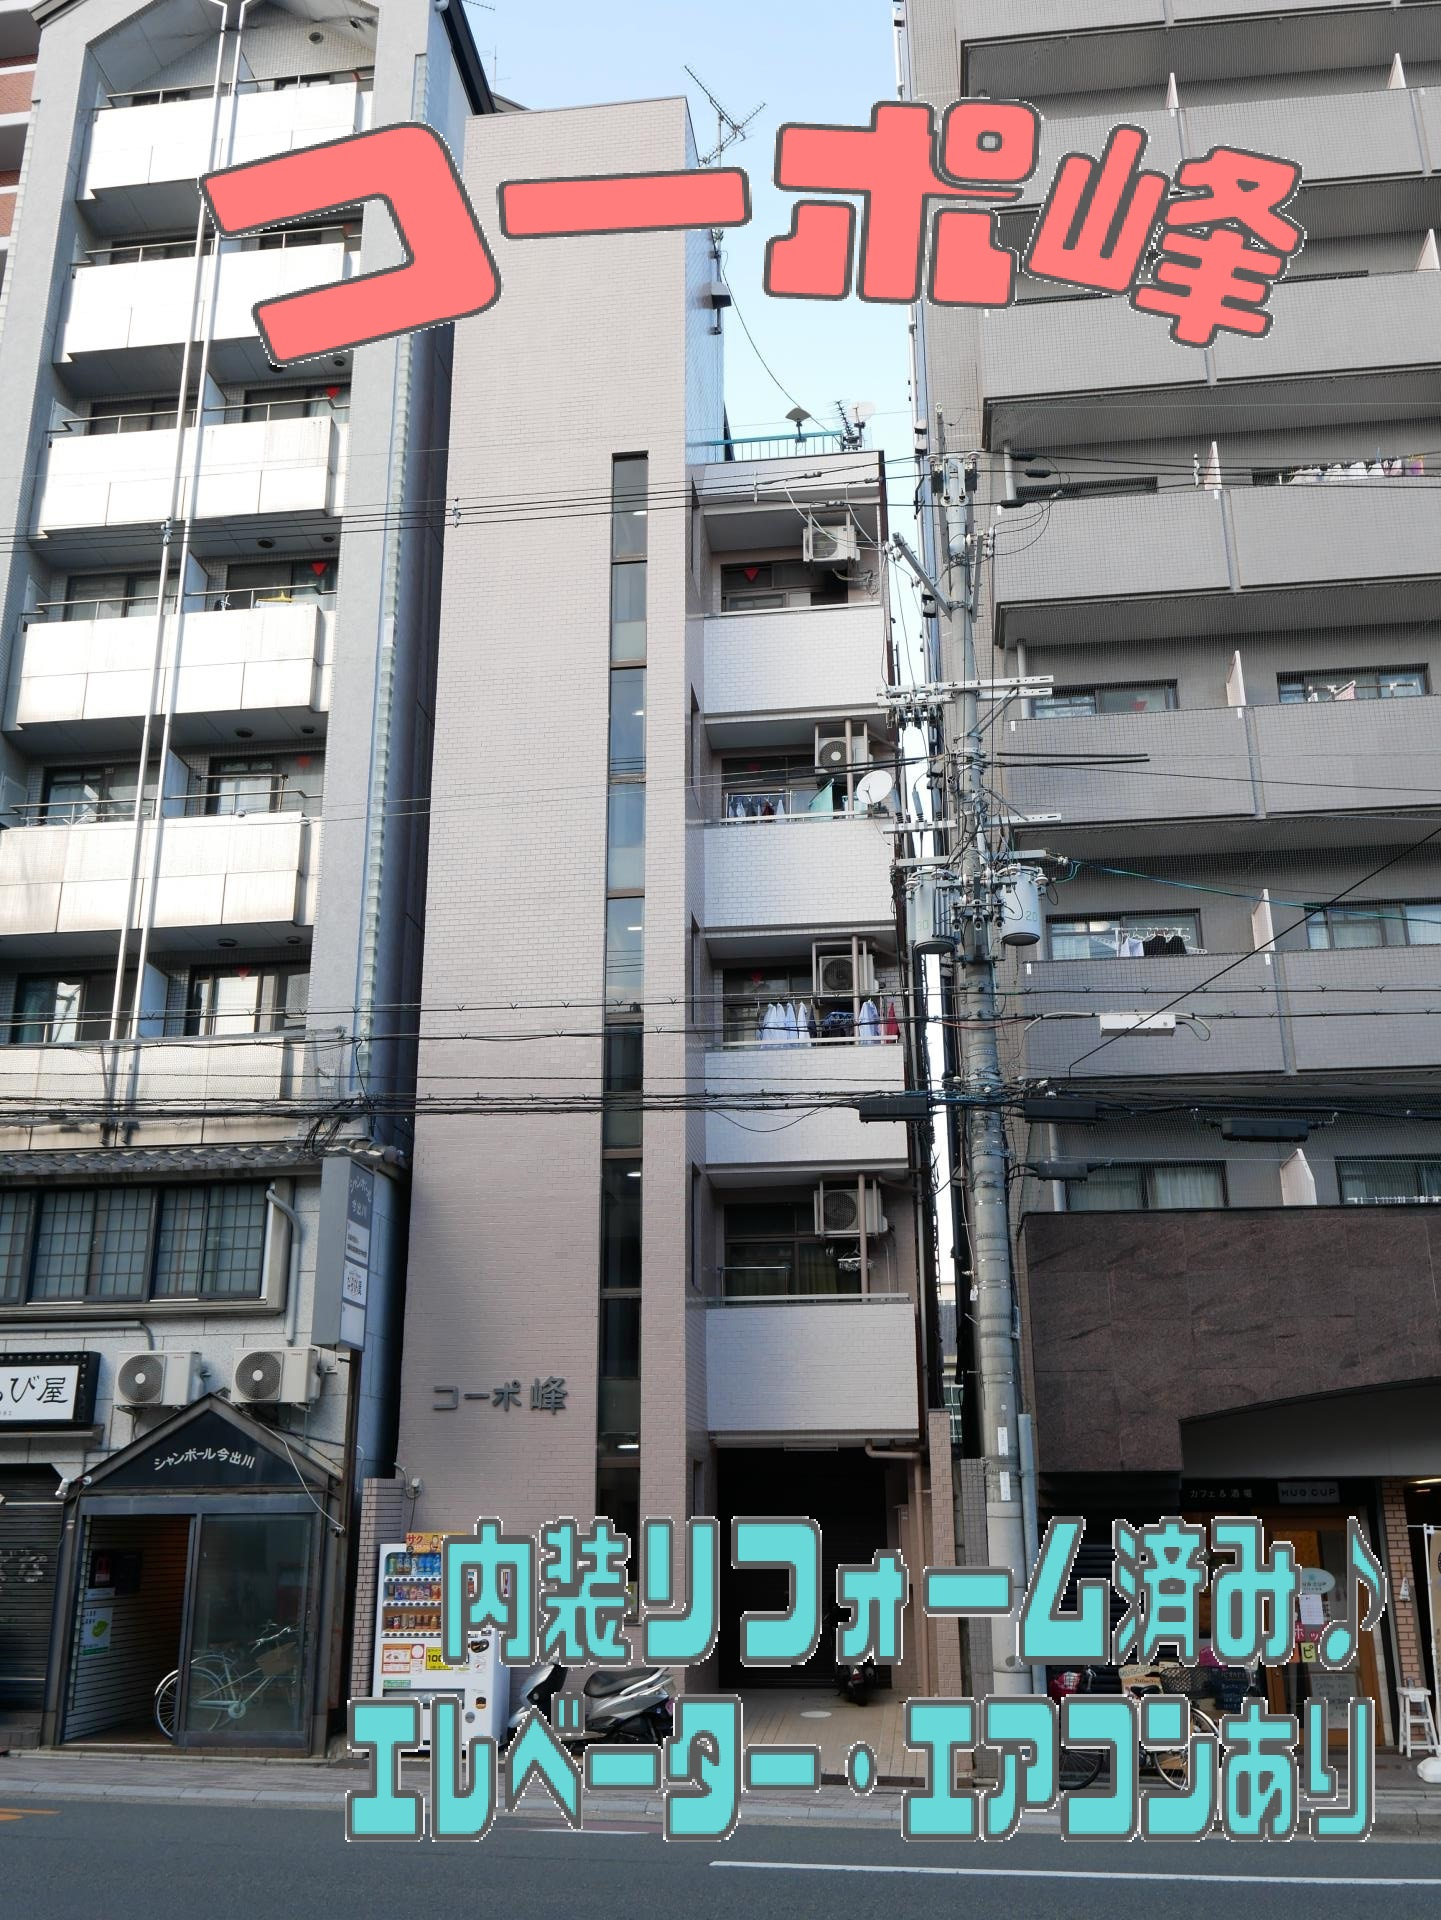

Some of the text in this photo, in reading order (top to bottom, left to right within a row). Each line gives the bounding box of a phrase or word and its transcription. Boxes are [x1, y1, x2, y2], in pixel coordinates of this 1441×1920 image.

[0, 1375, 68, 1404] び屋
[432, 1376, 568, 1415] コーポ峰
[154, 1448, 255, 1470] シャンボール今出川
[1281, 1488, 1337, 1497] MUG CUP
